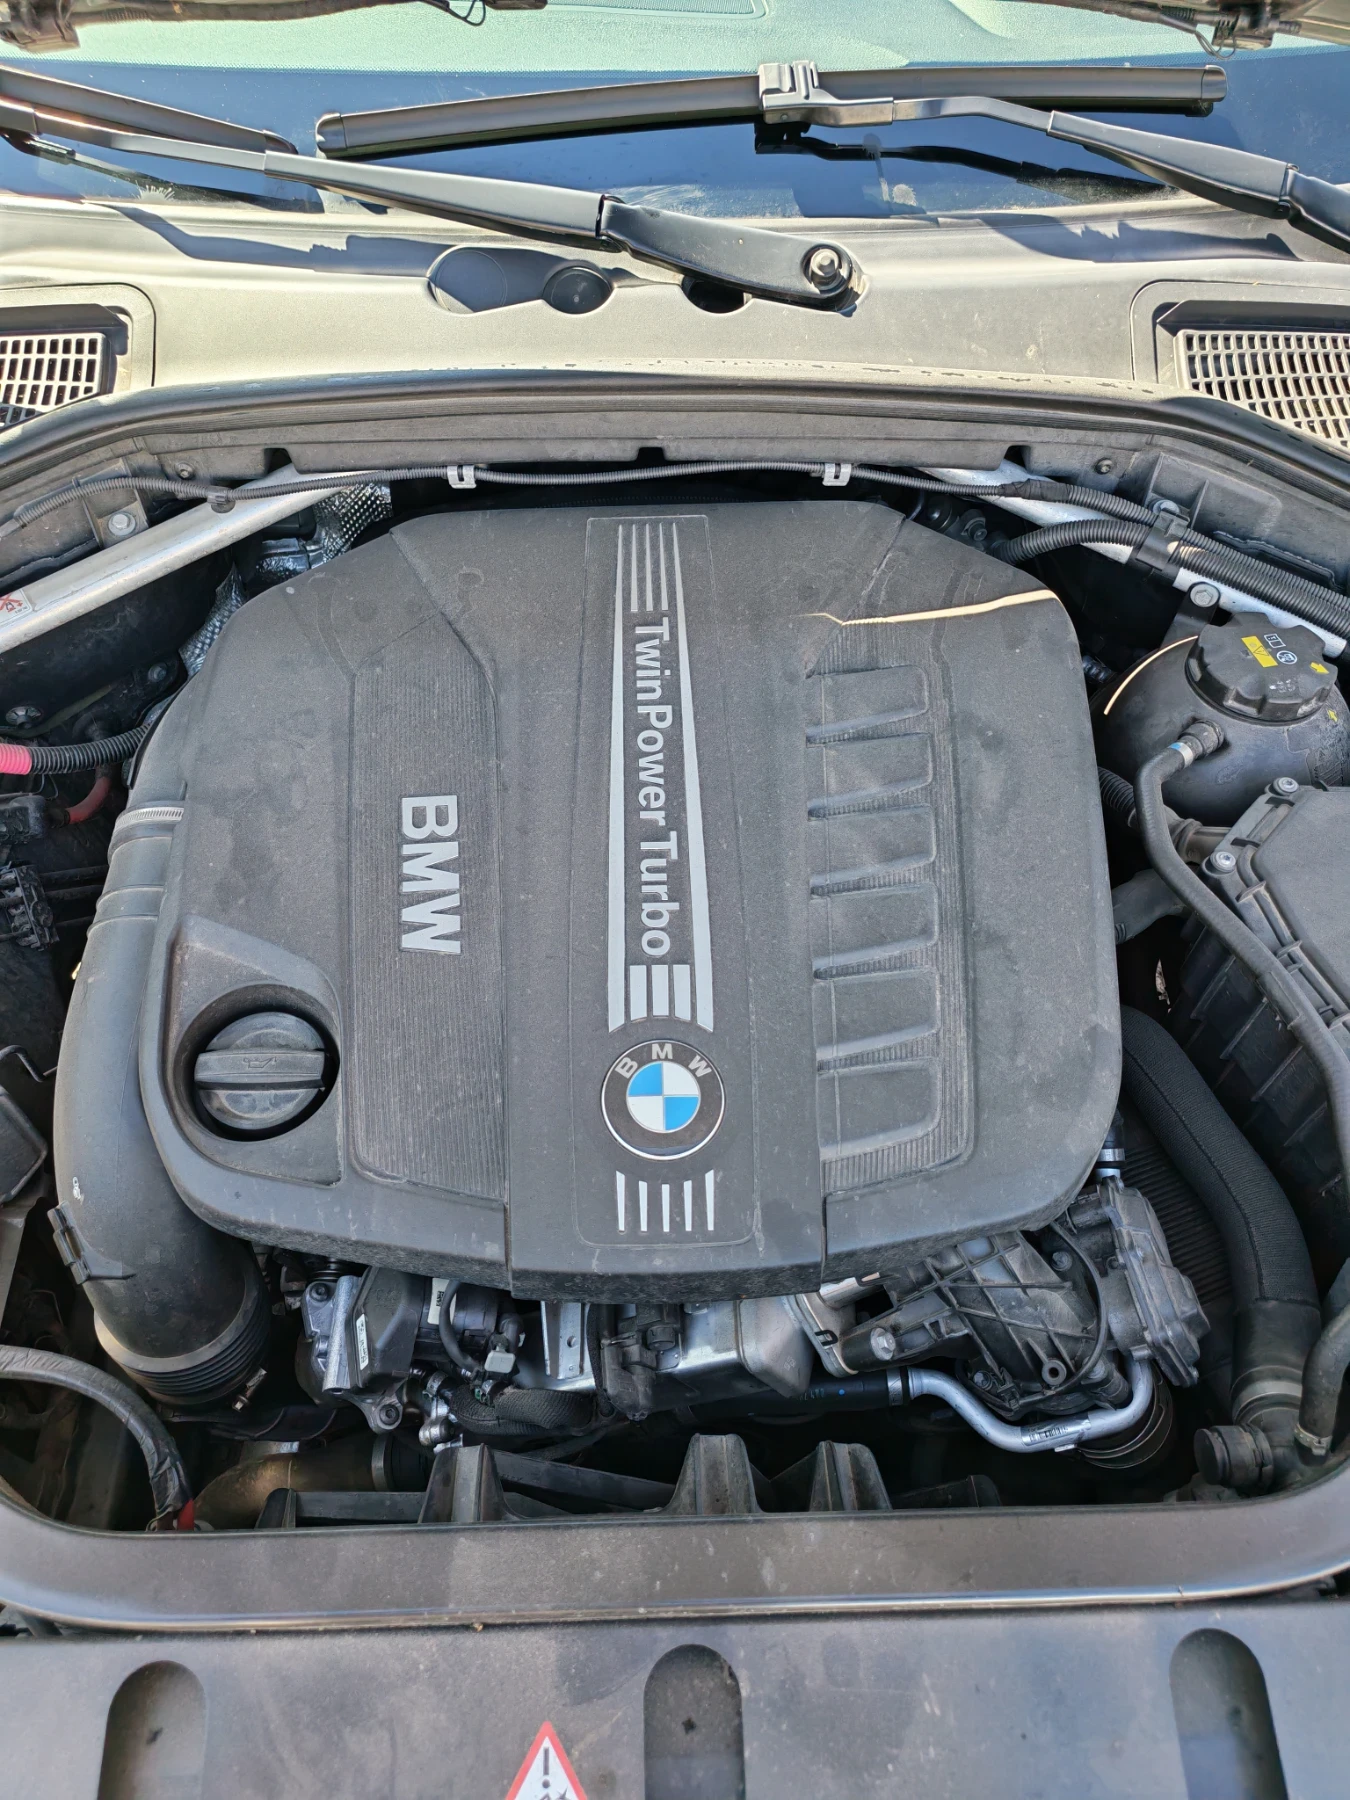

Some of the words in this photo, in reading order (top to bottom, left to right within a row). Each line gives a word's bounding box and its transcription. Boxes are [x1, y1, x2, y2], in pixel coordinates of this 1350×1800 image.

[635, 617, 673, 826] TwinPower
[402, 795, 461, 954] BMW
[639, 831, 680, 957] Turbo
[614, 1043, 712, 1079] BMW
